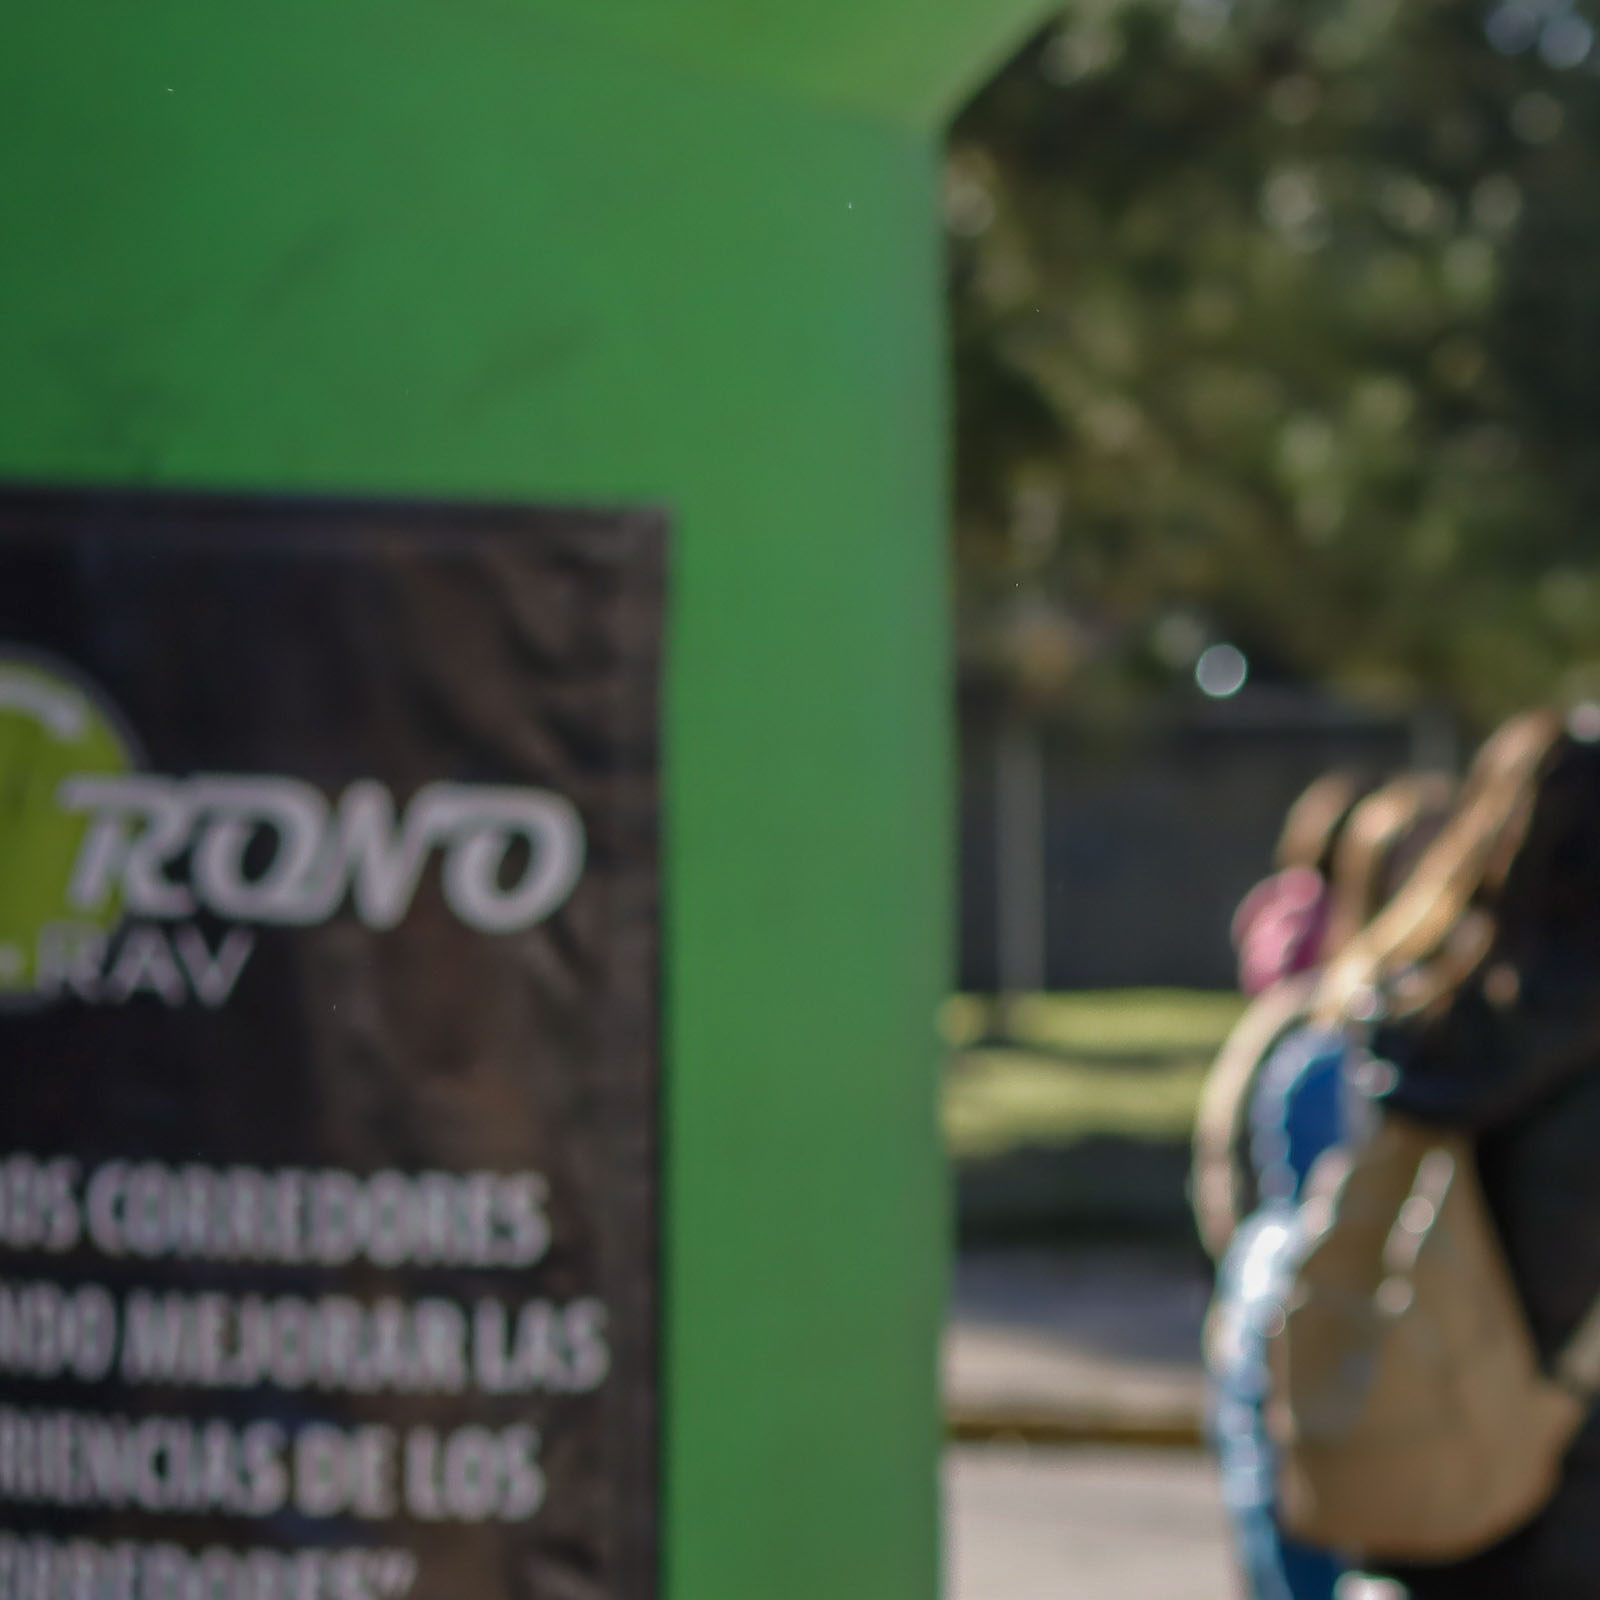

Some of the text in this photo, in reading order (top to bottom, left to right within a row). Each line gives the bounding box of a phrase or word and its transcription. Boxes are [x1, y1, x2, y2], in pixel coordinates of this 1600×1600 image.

[86, 1157, 552, 1268] CORREDORES
[120, 1288, 470, 1396] MEJORAR
[472, 1296, 611, 1396] LAS
[294, 1416, 397, 1520] DE
[405, 1420, 548, 1524] LOS
